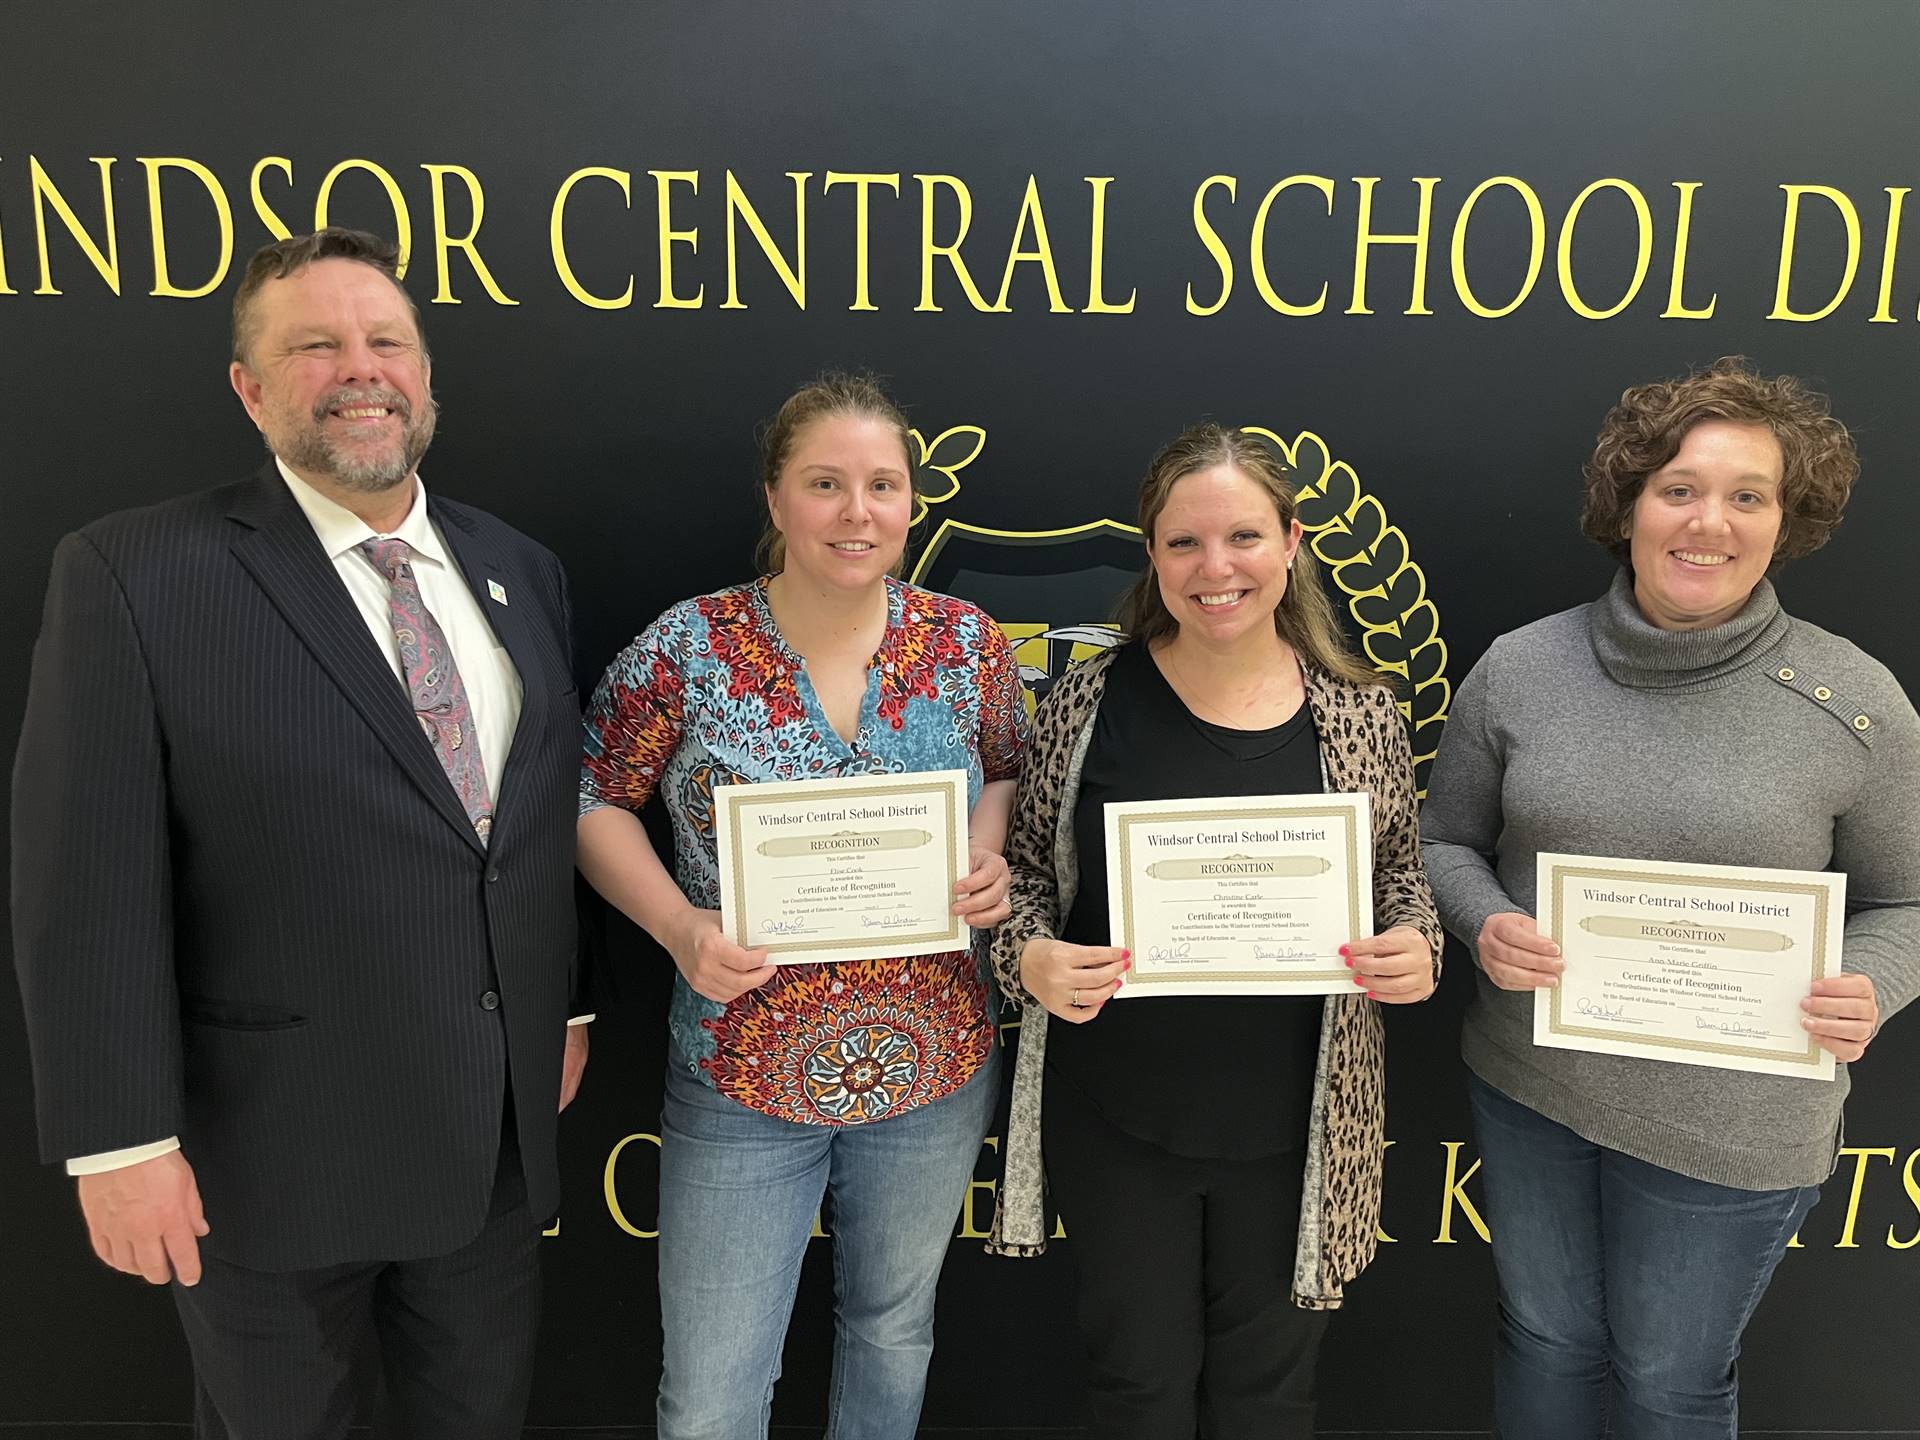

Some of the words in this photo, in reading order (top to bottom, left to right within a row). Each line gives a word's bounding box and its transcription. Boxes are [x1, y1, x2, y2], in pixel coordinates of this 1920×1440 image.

[551, 166, 1137, 315] CENTRAL
[1185, 174, 1717, 321] SCHOOL
[1765, 184, 1920, 323] DI
[758, 814, 804, 826] Windsor
[806, 809, 846, 823] Central
[849, 807, 885, 820] School
[888, 804, 928, 817] District
[810, 837, 880, 850] RECOGNITION
[1148, 835, 1194, 847] Windsor
[1196, 832, 1238, 845] Central
[1241, 830, 1279, 843] School
[1282, 829, 1326, 842] District
[1201, 862, 1274, 874] RECOGNITION
[797, 885, 839, 895] Certificate
[840, 883, 849, 892] of
[850, 881, 896, 892] Recognition
[1583, 889, 1636, 905] Windsor
[1638, 893, 1686, 909] Central
[1690, 898, 1734, 913] School
[1739, 901, 1790, 918] District
[1187, 912, 1231, 921] Certificate
[1232, 911, 1241, 920] of
[1242, 911, 1292, 922] Recognition
[1641, 925, 1727, 943] RECOGNITION
[1622, 971, 1671, 986] Certificate
[1673, 976, 1683, 986] of
[1685, 977, 1742, 993] Recognition
